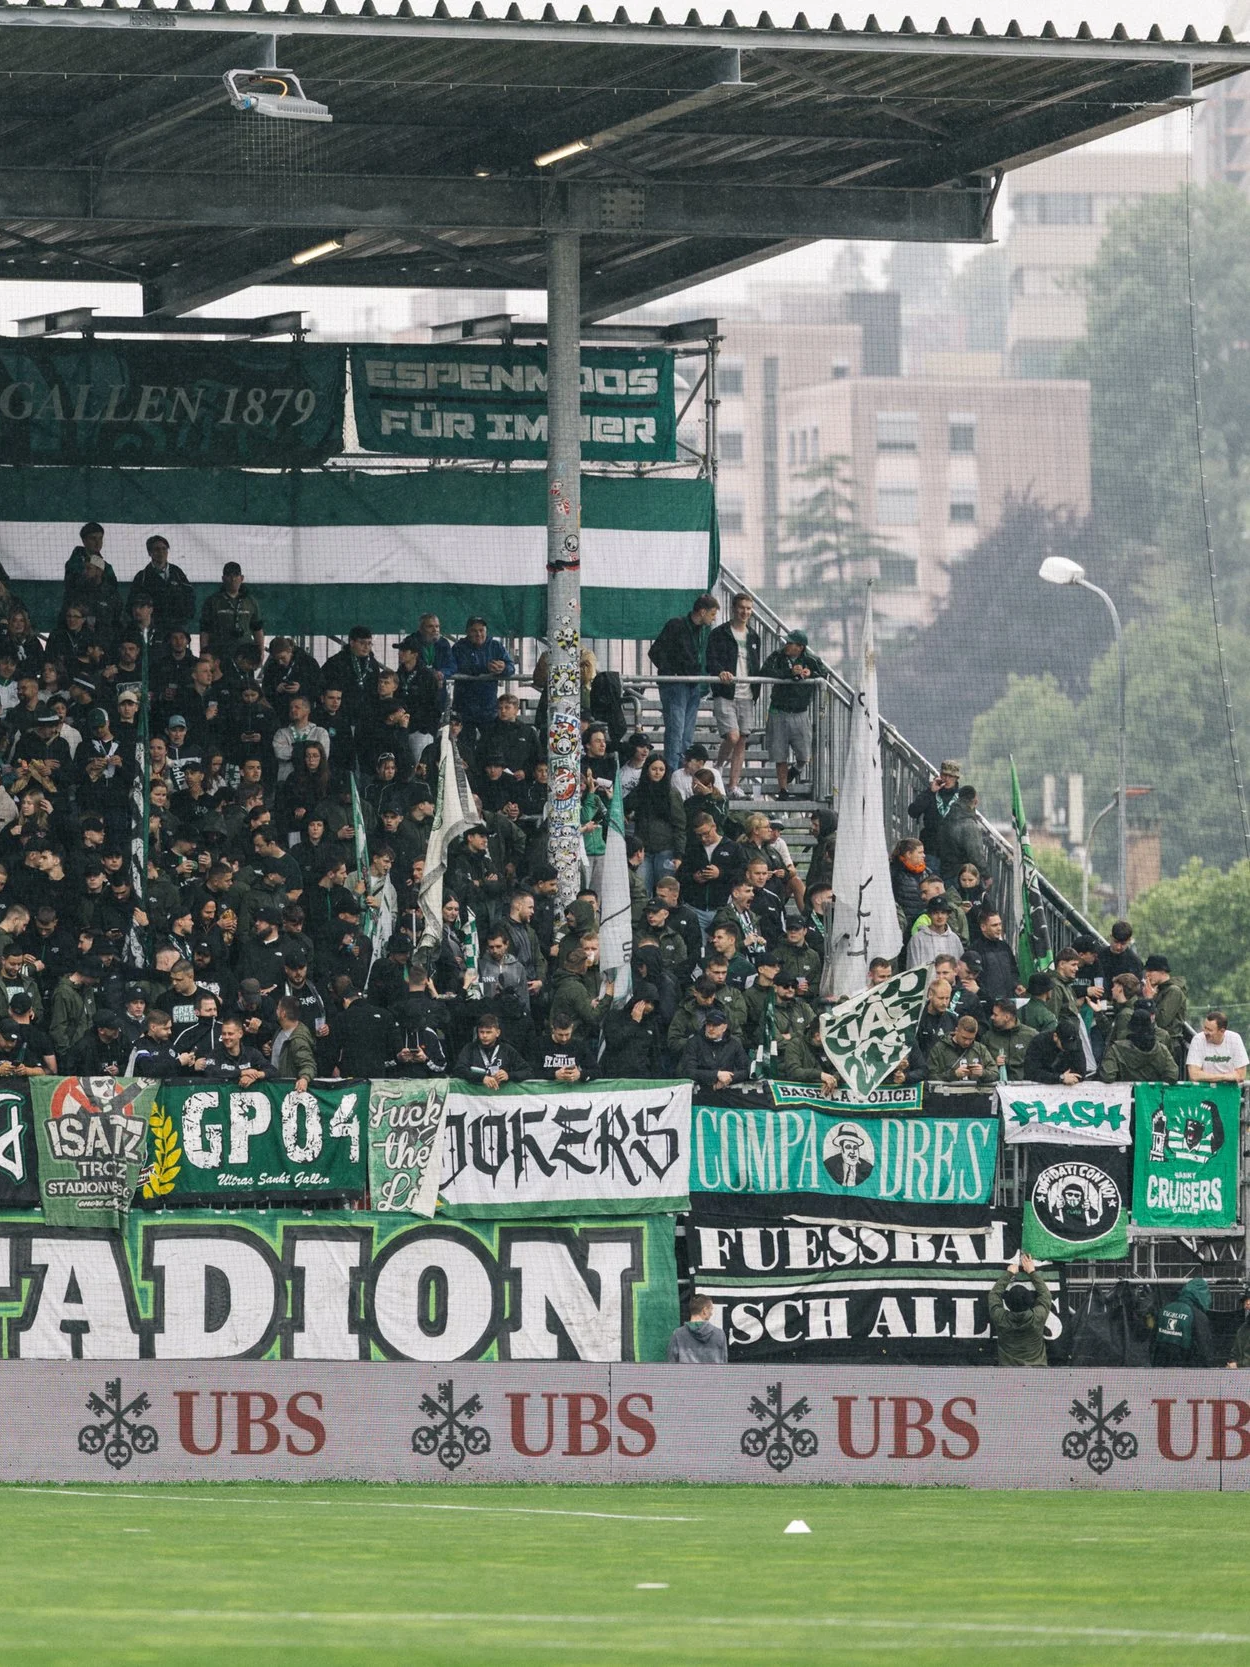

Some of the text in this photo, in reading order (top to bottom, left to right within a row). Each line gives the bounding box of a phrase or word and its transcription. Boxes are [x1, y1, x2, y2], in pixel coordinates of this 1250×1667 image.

[0, 382, 205, 425] GALLEN
[218, 388, 316, 427] 1879
[380, 402, 656, 443] FÜR IMER
[370, 1087, 442, 1128] Fuck
[854, 1089, 916, 1104] OLICE!
[1009, 1100, 1127, 1131] FLASH
[372, 1131, 431, 1168] the
[217, 1171, 330, 1188] Ultras Sankt Gallen
[1079, 1166, 1104, 1183] CON
[1146, 1174, 1223, 1211] CRUISERS
[694, 1221, 1052, 1271] FUESSBAL
[868, 1297, 1064, 1340] ALLS
[173, 1390, 327, 1457] UBS
[505, 1391, 657, 1458] UBS
[832, 1396, 980, 1461] UBS
